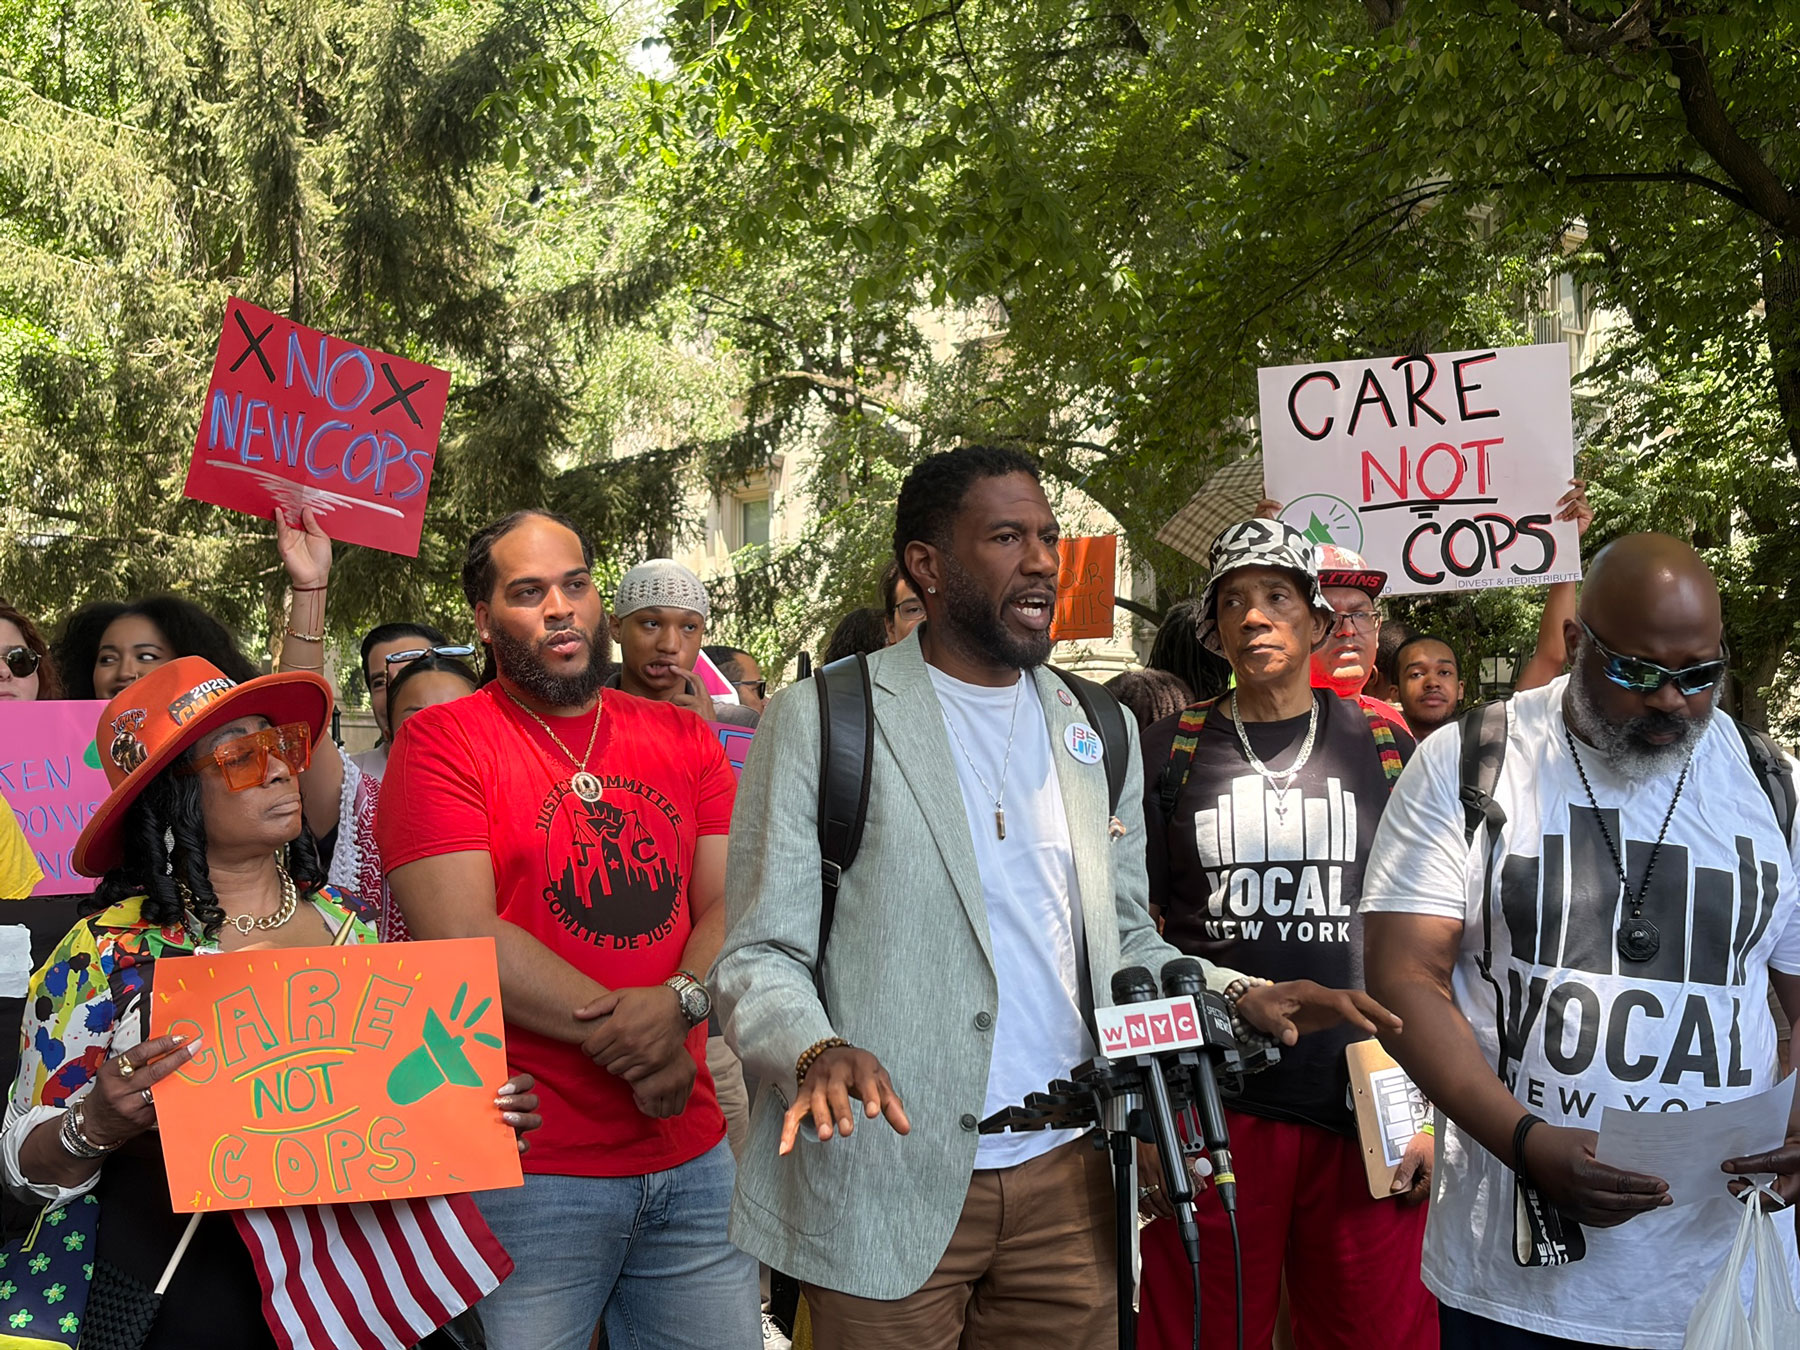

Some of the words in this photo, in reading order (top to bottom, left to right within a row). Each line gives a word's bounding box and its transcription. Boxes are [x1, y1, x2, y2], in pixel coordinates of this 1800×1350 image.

[286, 330, 375, 412] NO
[1287, 351, 1500, 441] CARE
[208, 388, 306, 467] NEW
[304, 420, 433, 500] COPS
[1361, 437, 1504, 503] NOT
[1402, 513, 1558, 585] COPS
[1457, 578, 1494, 589] DIVEST
[1496, 577, 1505, 586] &
[1507, 572, 1580, 585] REDISTRIBUTE
[190, 677, 229, 700] 2026
[1072, 725, 1097, 742] BE
[1072, 738, 1098, 760] LOVE
[541, 886, 606, 949] COMITE
[612, 934, 640, 950] DE
[1204, 866, 1351, 917] VOCAL
[1204, 920, 1264, 941] NEW
[1276, 921, 1351, 943] YORK
[164, 968, 414, 1085] CARE
[1102, 1016, 1193, 1042] WNYC
[1506, 968, 1753, 1088] VOCAL
[251, 1060, 345, 1120] NOT
[209, 1115, 417, 1201] COPS
